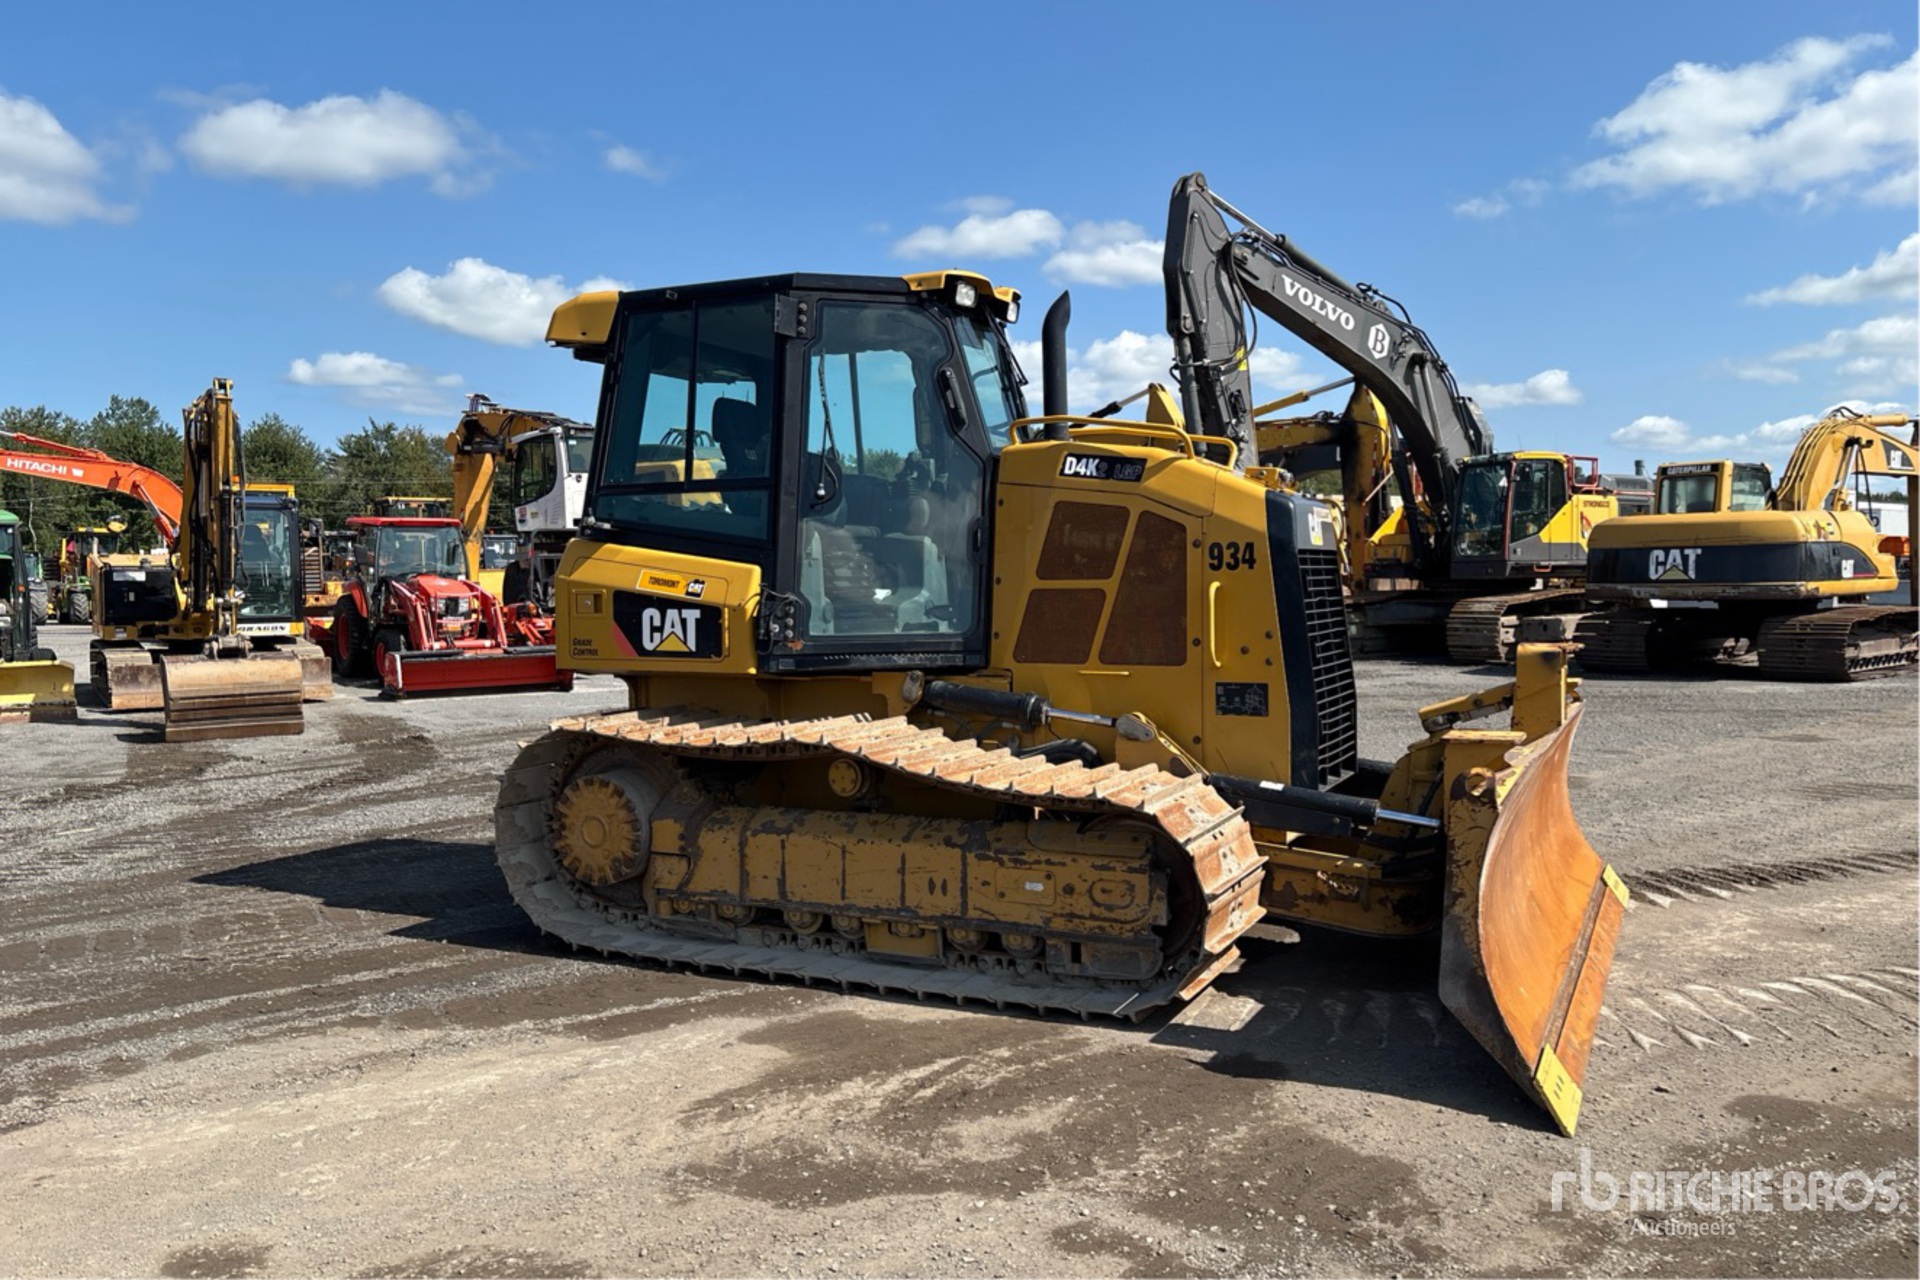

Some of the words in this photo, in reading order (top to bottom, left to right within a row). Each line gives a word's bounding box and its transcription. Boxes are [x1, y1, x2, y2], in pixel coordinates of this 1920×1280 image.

[1281, 274, 1355, 331] VOLVO
[6, 457, 68, 475] HITACHI
[1208, 541, 1257, 571] 934
[1648, 548, 1702, 580] CAT
[648, 576, 681, 589] TOROMONT
[687, 582, 704, 593] CAT
[641, 607, 701, 652] CAT
[572, 637, 593, 647] GRADE
[572, 647, 599, 657] CONTROL
